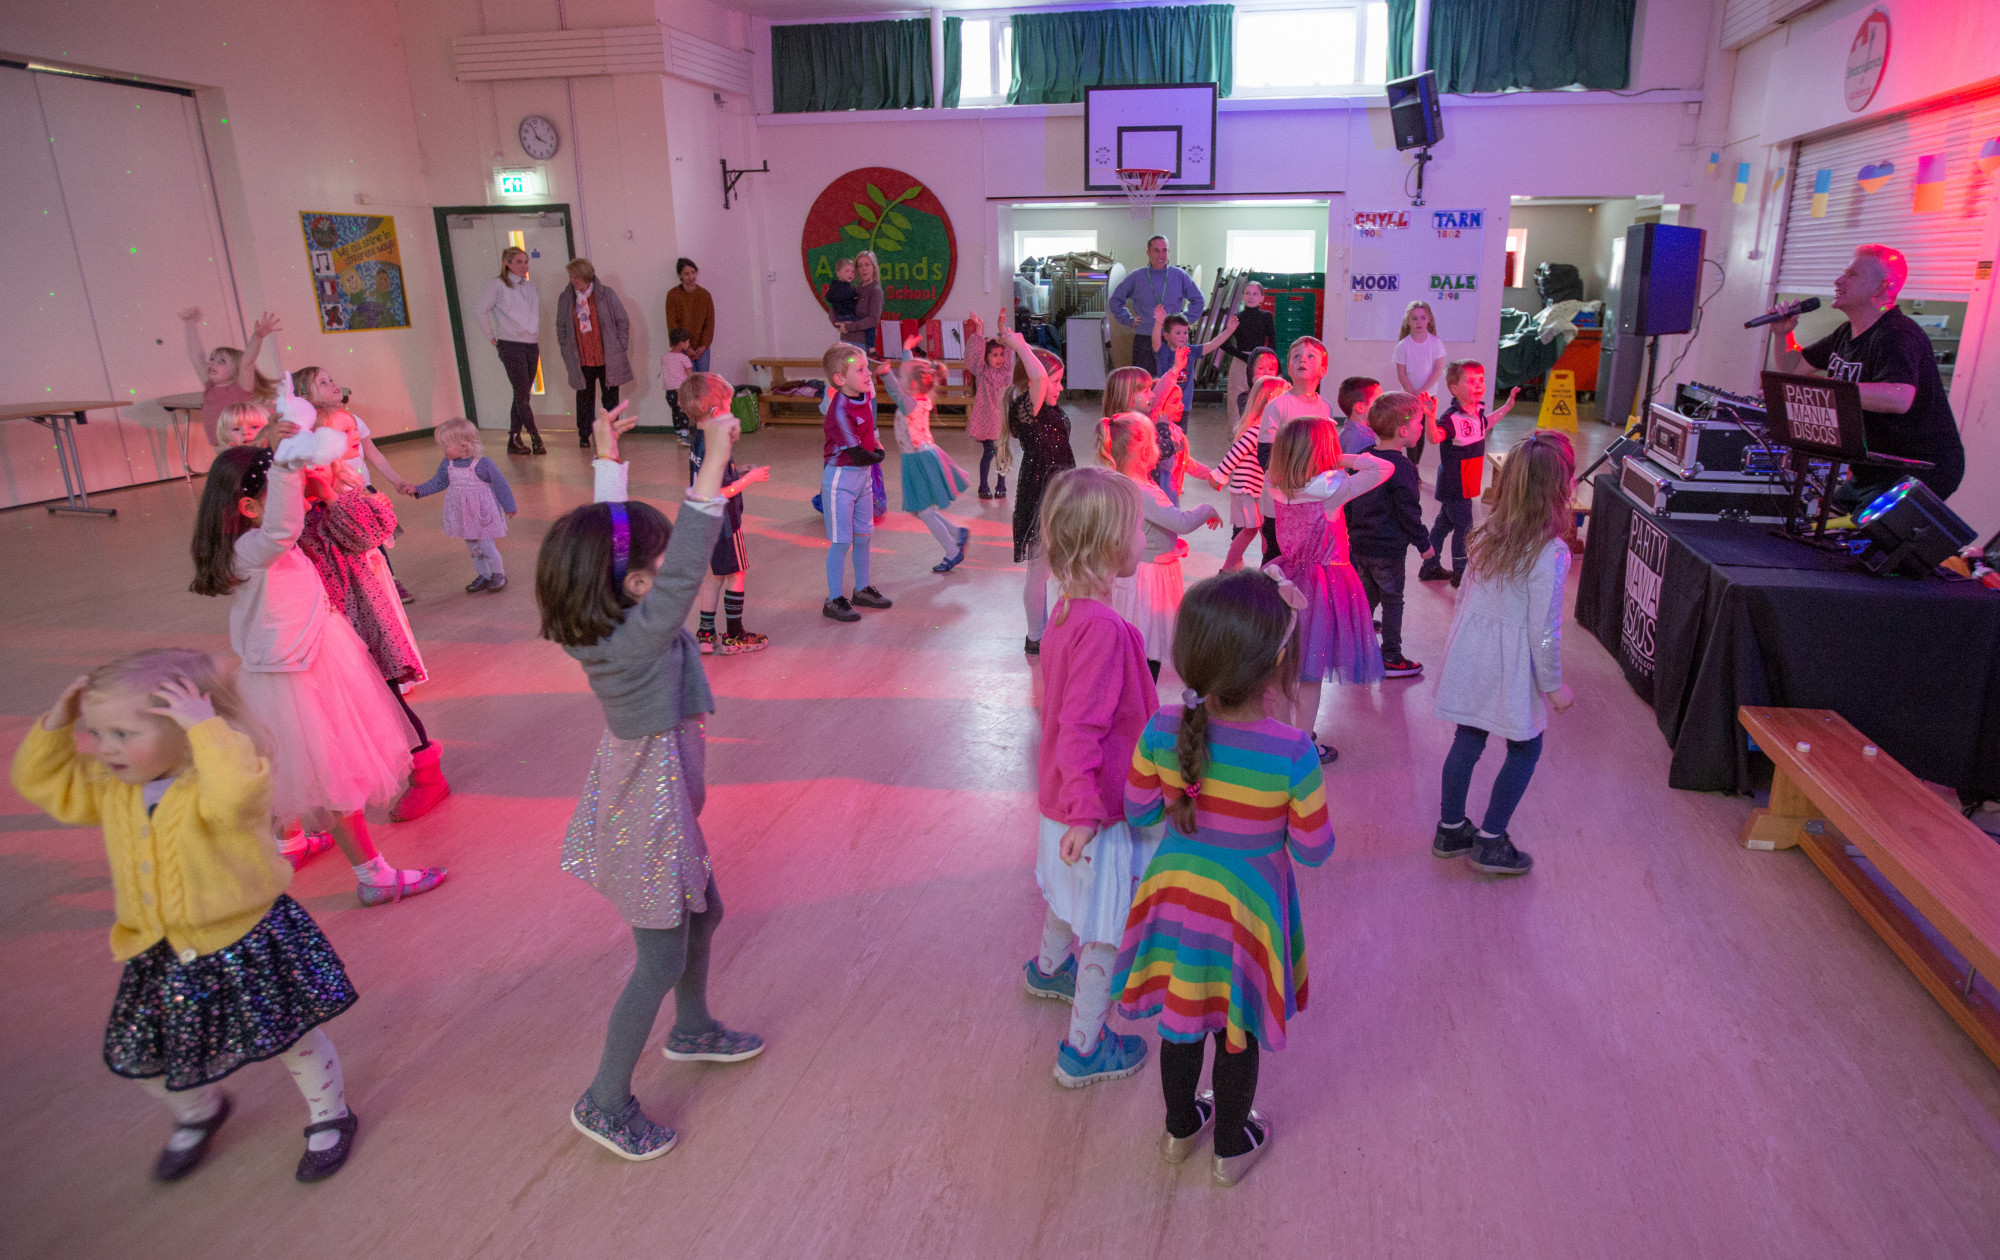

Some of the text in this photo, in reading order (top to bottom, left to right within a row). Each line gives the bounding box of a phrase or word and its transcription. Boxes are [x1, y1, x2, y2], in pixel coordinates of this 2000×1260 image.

[1434, 211, 1481, 228] TARN
[1437, 230, 1461, 239] 1802
[814, 255, 943, 281] Aands
[1352, 275, 1398, 290] MOOR
[1430, 275, 1477, 290] DALE
[885, 285, 936, 301] School
[1438, 292, 1460, 301] 2198
[1785, 384, 1831, 408] PARTY
[1791, 402, 1833, 427] MANIA
[1793, 421, 1837, 446] DISCOS
[1629, 514, 1667, 574] PARTY
[1626, 551, 1660, 613] MANIA
